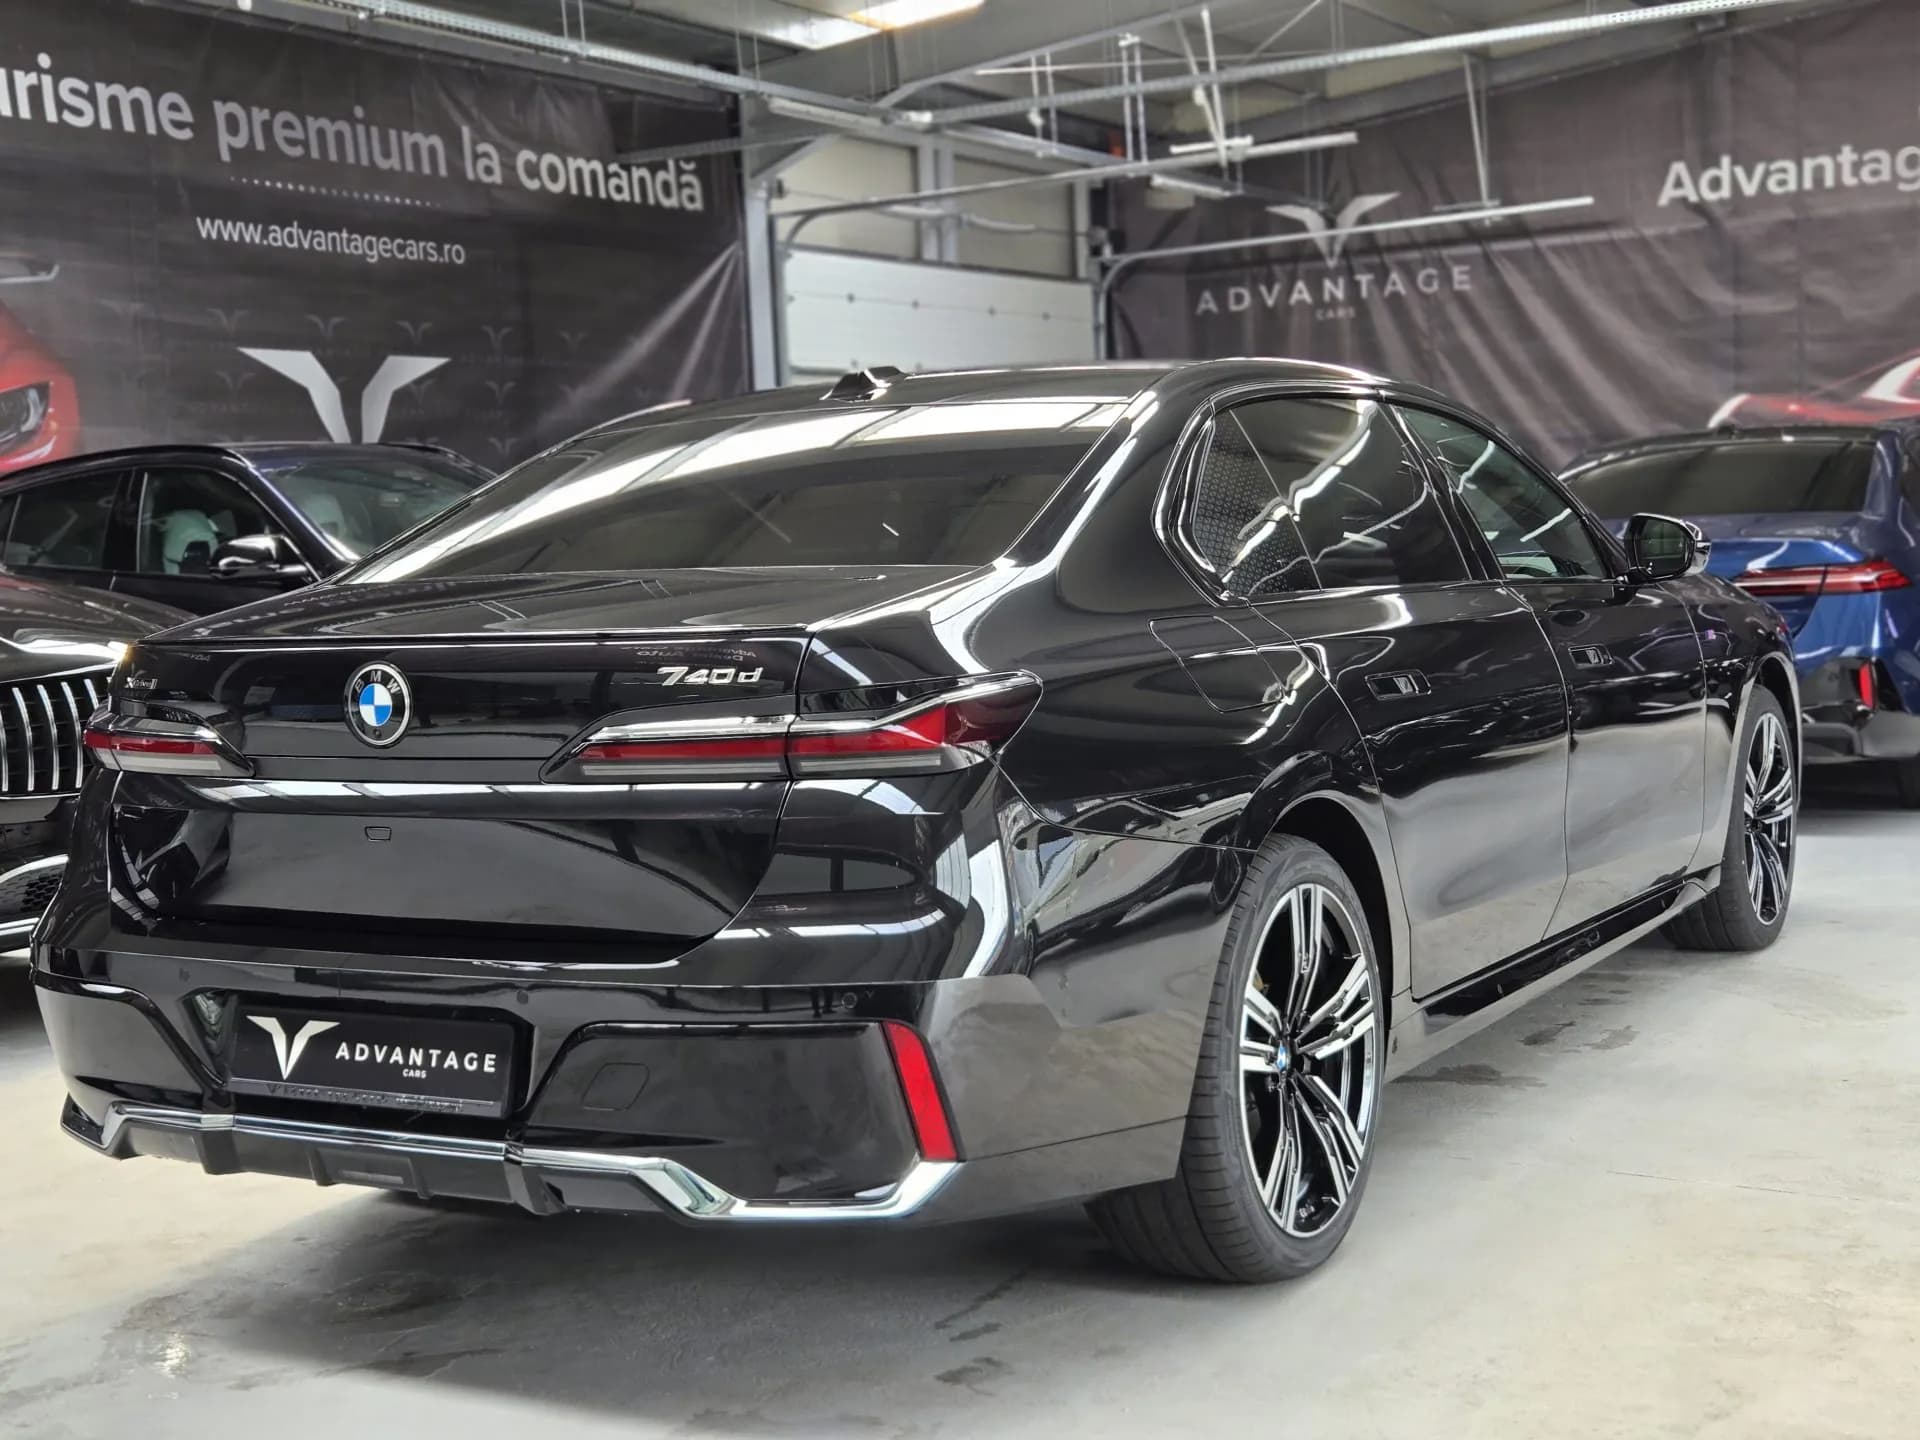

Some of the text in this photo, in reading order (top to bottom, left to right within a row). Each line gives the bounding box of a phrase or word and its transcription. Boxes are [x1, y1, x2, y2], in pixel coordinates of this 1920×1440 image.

[213, 100, 448, 177] premium
[461, 125, 503, 185] la
[516, 149, 704, 211] comandă
[196, 216, 466, 264] www.advantagecars.ro
[1196, 265, 1472, 315] ADVANTAGE
[354, 670, 402, 695] BMW
[657, 666, 764, 687] 740d
[335, 1041, 497, 1074] ADVANTAGE
[402, 1068, 427, 1079] CARS
